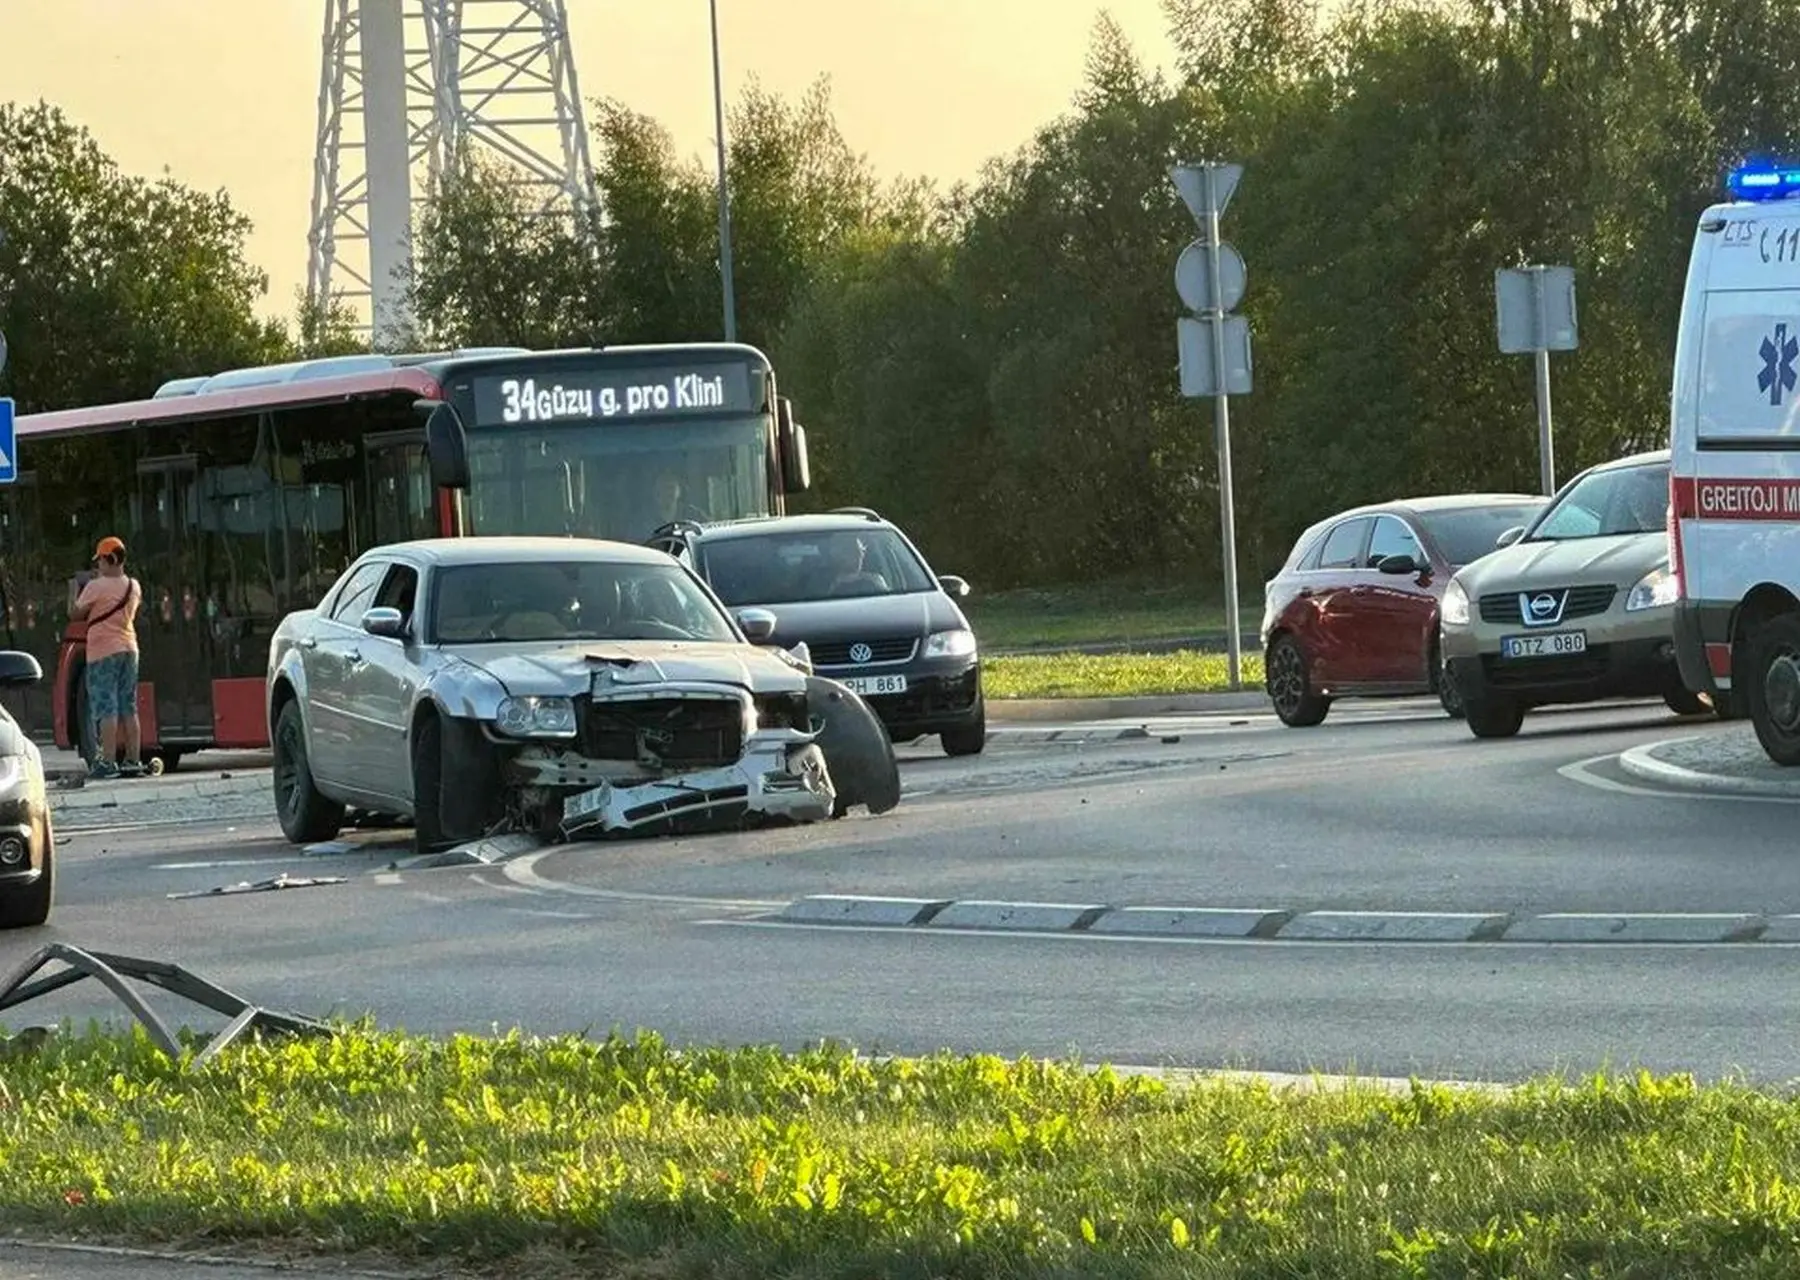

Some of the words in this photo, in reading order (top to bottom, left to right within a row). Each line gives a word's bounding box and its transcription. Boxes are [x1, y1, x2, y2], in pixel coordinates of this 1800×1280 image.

[600, 387, 622, 416] g.
[627, 384, 669, 414] pro
[674, 373, 723, 408] Klini
[1702, 486, 1778, 512] GREITOJI
[1783, 486, 1800, 512] M
[876, 676, 903, 691] 861
